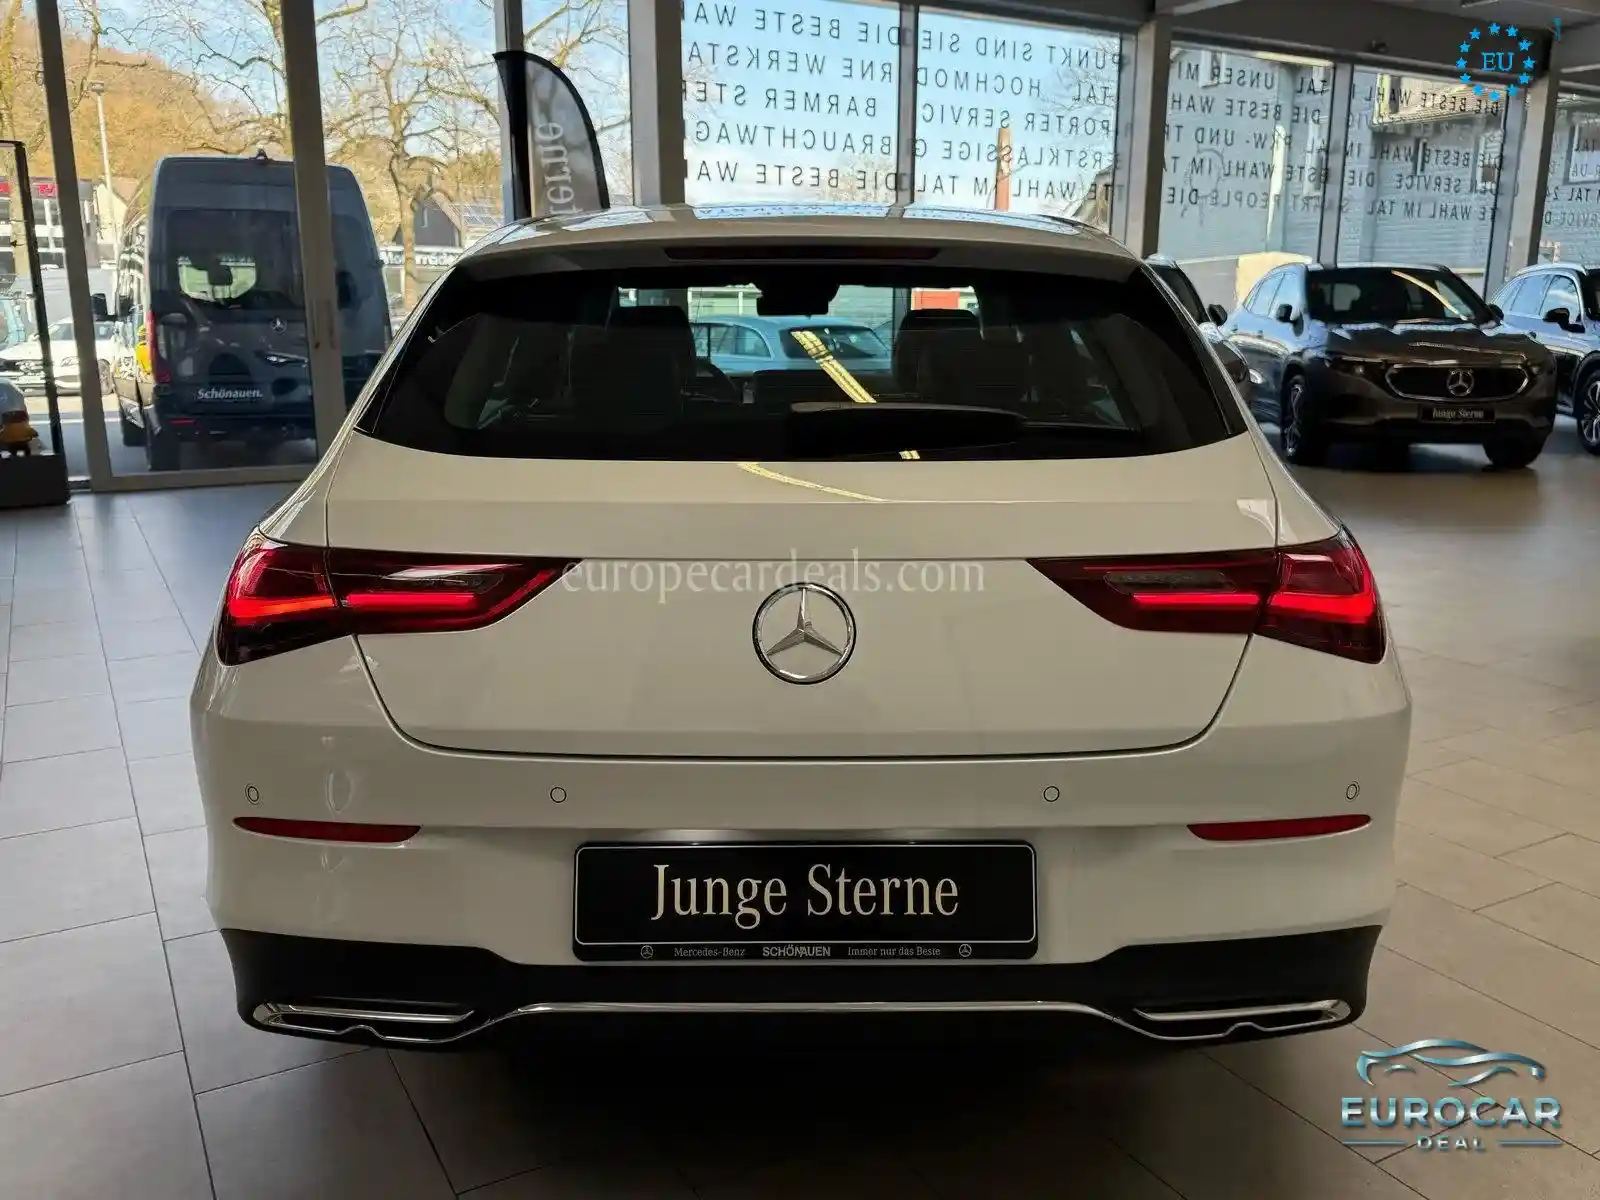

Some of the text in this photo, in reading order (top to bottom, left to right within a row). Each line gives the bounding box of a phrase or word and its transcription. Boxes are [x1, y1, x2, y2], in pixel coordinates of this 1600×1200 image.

[650, 863, 960, 930] Junge Sterne
[673, 947, 747, 958] Mercedes-Benz
[762, 945, 831, 957] SCHÖNAUEN
[848, 946, 877, 957] Immer
[916, 946, 941, 957] Beste
